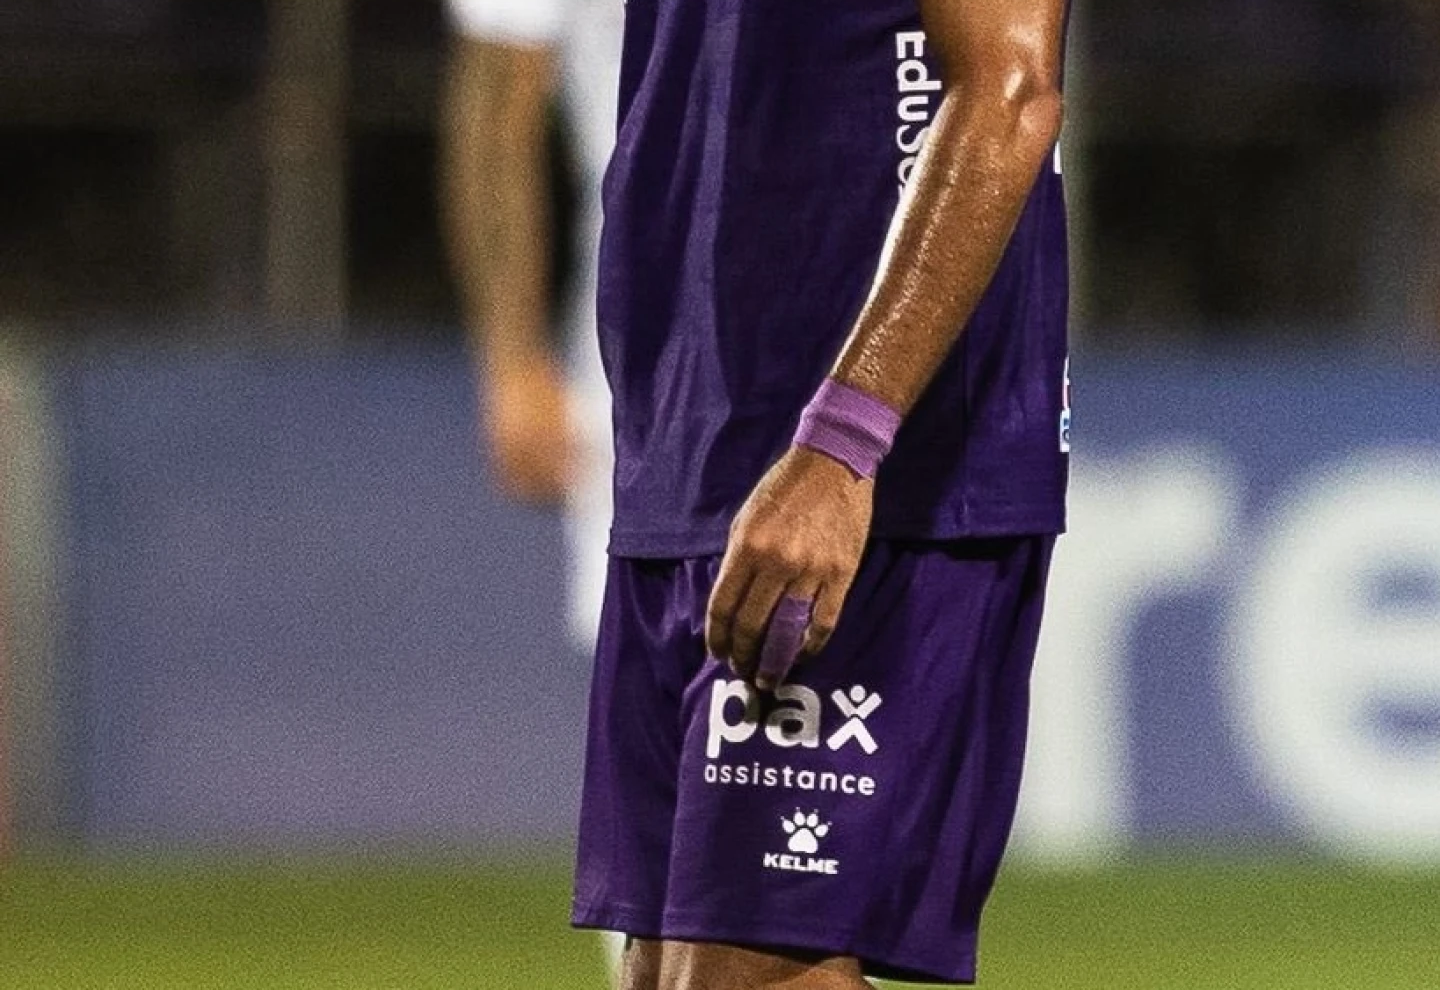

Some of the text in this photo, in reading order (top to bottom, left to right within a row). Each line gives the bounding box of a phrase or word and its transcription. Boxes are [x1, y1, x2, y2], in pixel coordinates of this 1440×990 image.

[706, 678, 883, 759] pax
[704, 763, 877, 796] assistance
[762, 852, 840, 875] KELME
